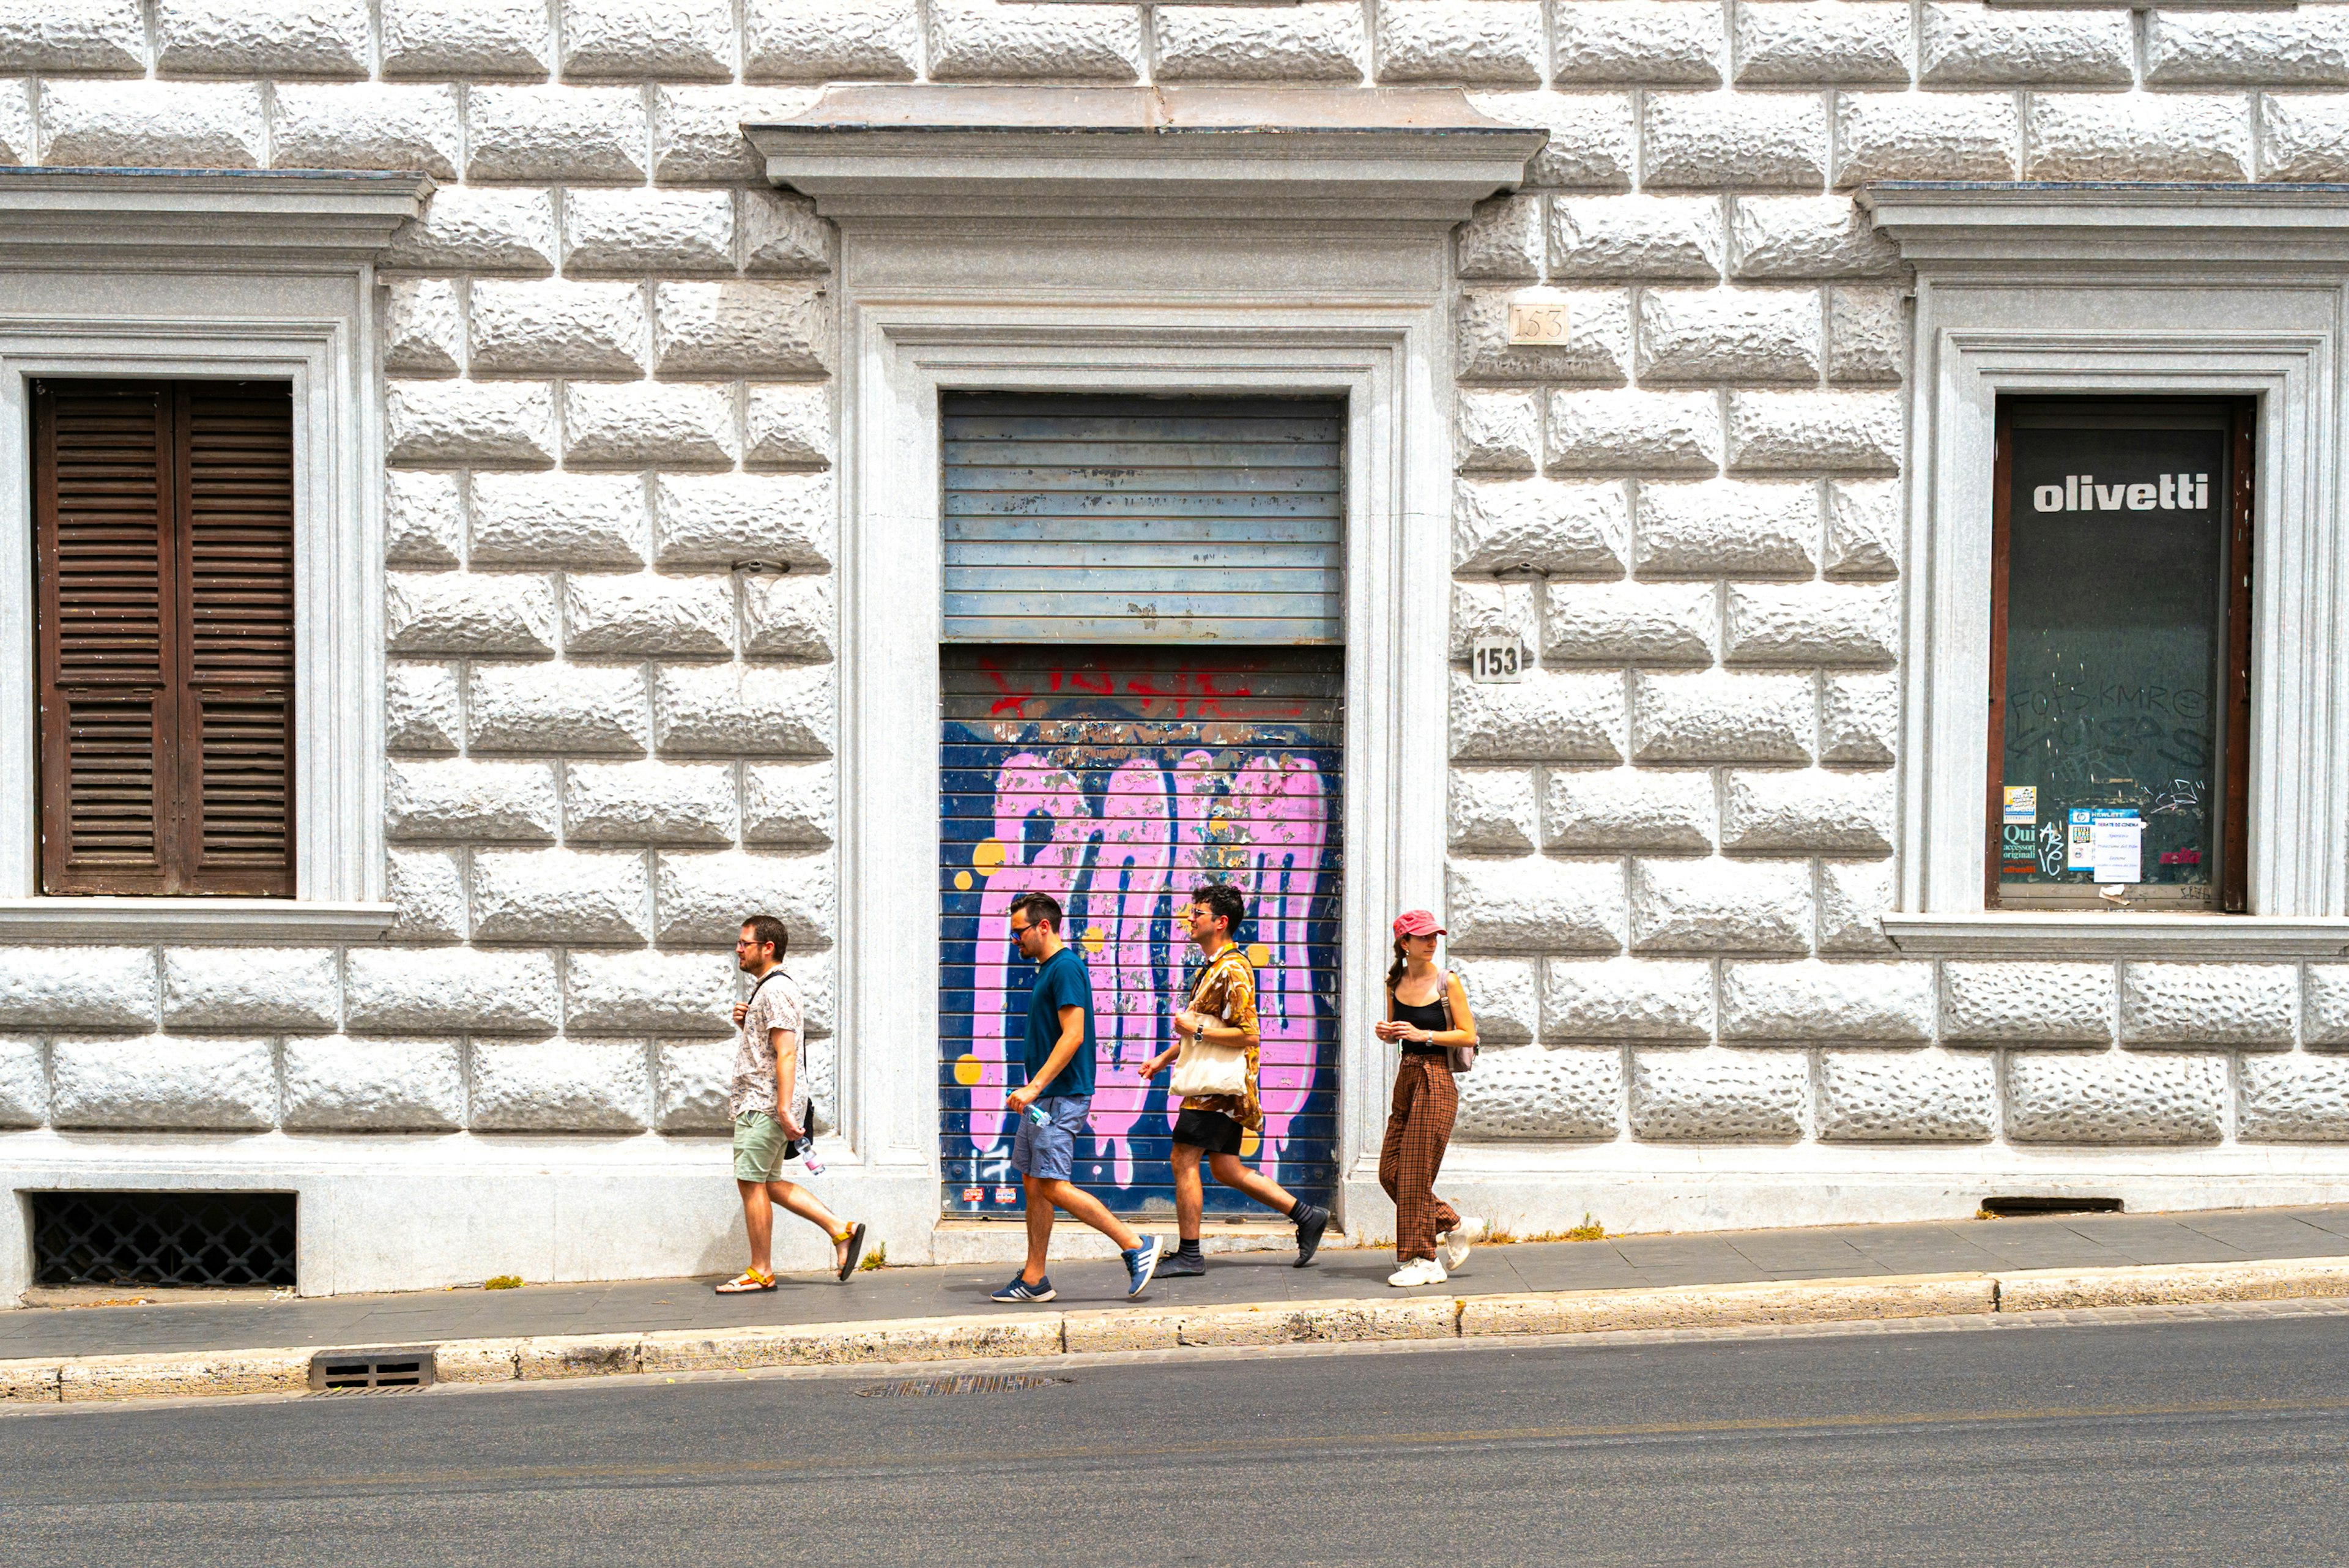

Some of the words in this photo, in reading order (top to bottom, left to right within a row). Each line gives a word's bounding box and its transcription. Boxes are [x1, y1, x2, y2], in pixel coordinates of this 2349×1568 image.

[1514, 308, 1562, 337] 153
[2033, 473, 2209, 513] olivetti
[1477, 647, 1518, 675] 153
[2004, 825, 2036, 845] Qui
[2003, 851, 2036, 860] originali
